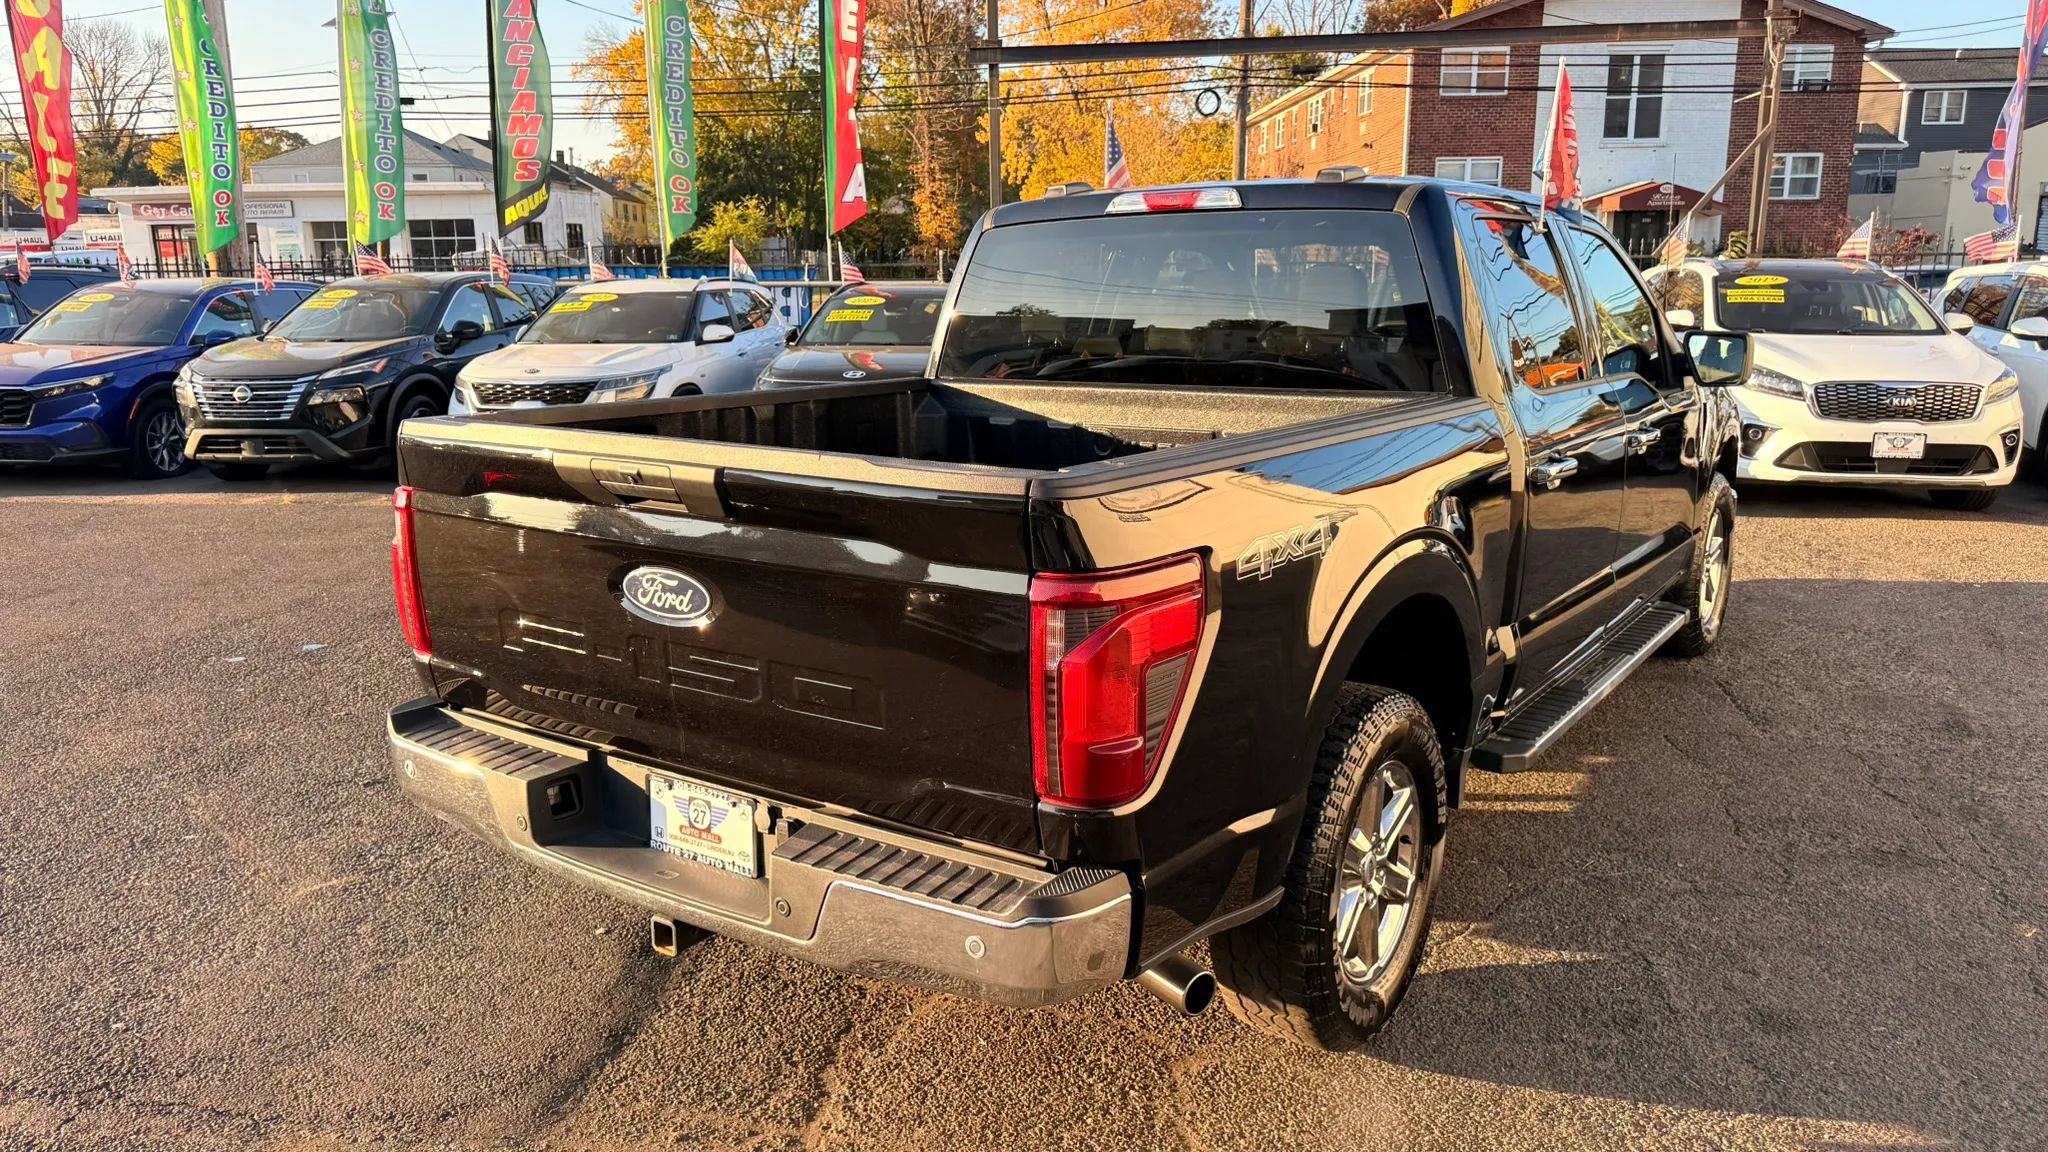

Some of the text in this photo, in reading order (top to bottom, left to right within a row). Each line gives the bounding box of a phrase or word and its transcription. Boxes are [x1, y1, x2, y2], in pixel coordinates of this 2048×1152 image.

[370, 29, 397, 174] CREDITO
[664, 15, 693, 215] CREDITO OK
[213, 190, 233, 227] OK
[374, 181, 397, 221] OK
[1892, 397, 1912, 407] KIA
[637, 574, 693, 613] Ford
[499, 607, 887, 731] F-150
[681, 827, 720, 843] AUTO MALL
[692, 807, 707, 826] 27
[650, 840, 753, 878] ROUTE 27 AUTO MALL
